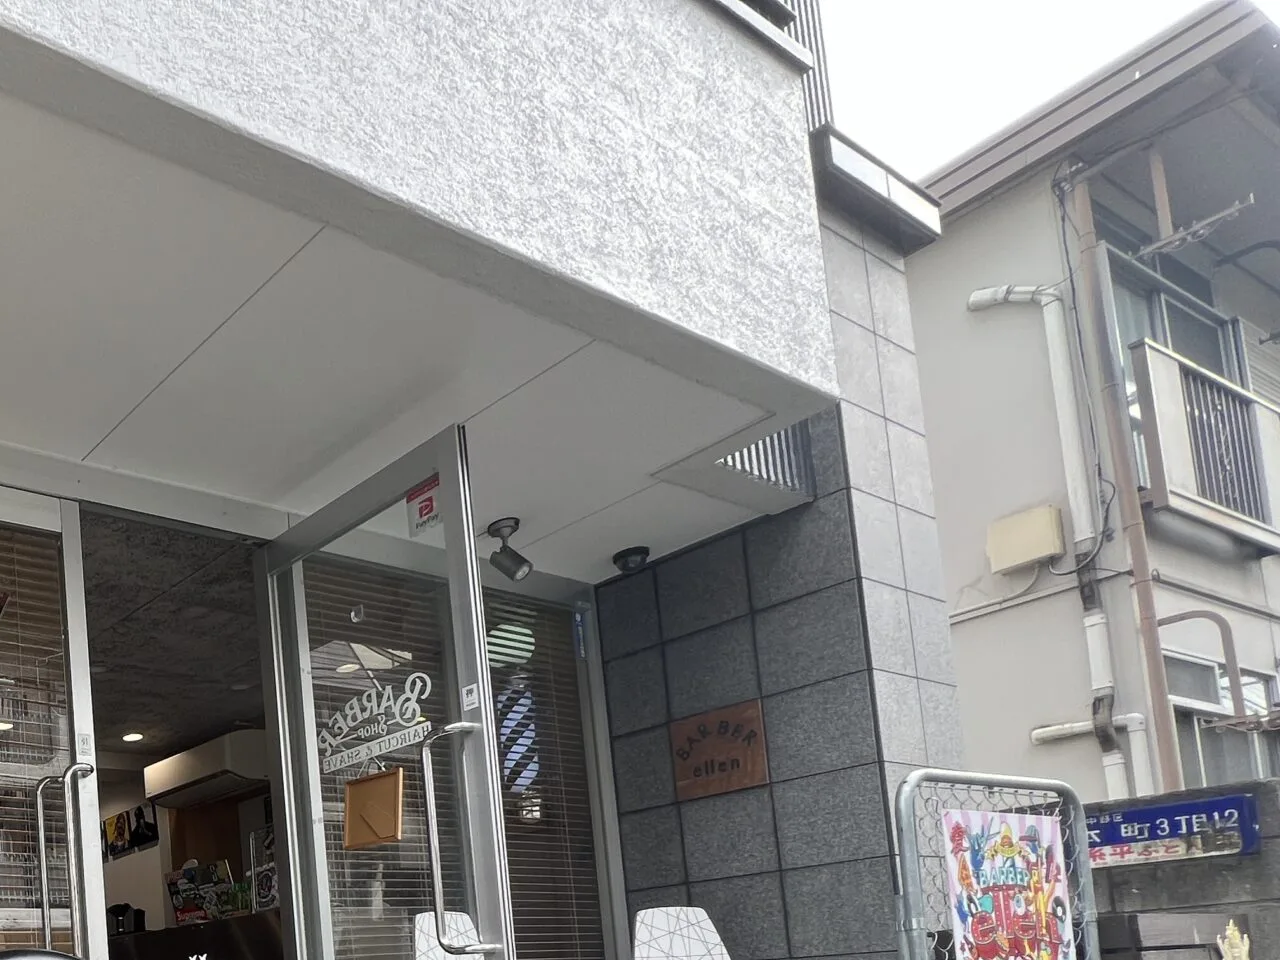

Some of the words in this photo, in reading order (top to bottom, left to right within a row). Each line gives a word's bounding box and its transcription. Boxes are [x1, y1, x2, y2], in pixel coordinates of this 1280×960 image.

[675, 720, 758, 761] BARBER
[693, 758, 741, 778] ellen
[971, 888, 1063, 944] ellen
